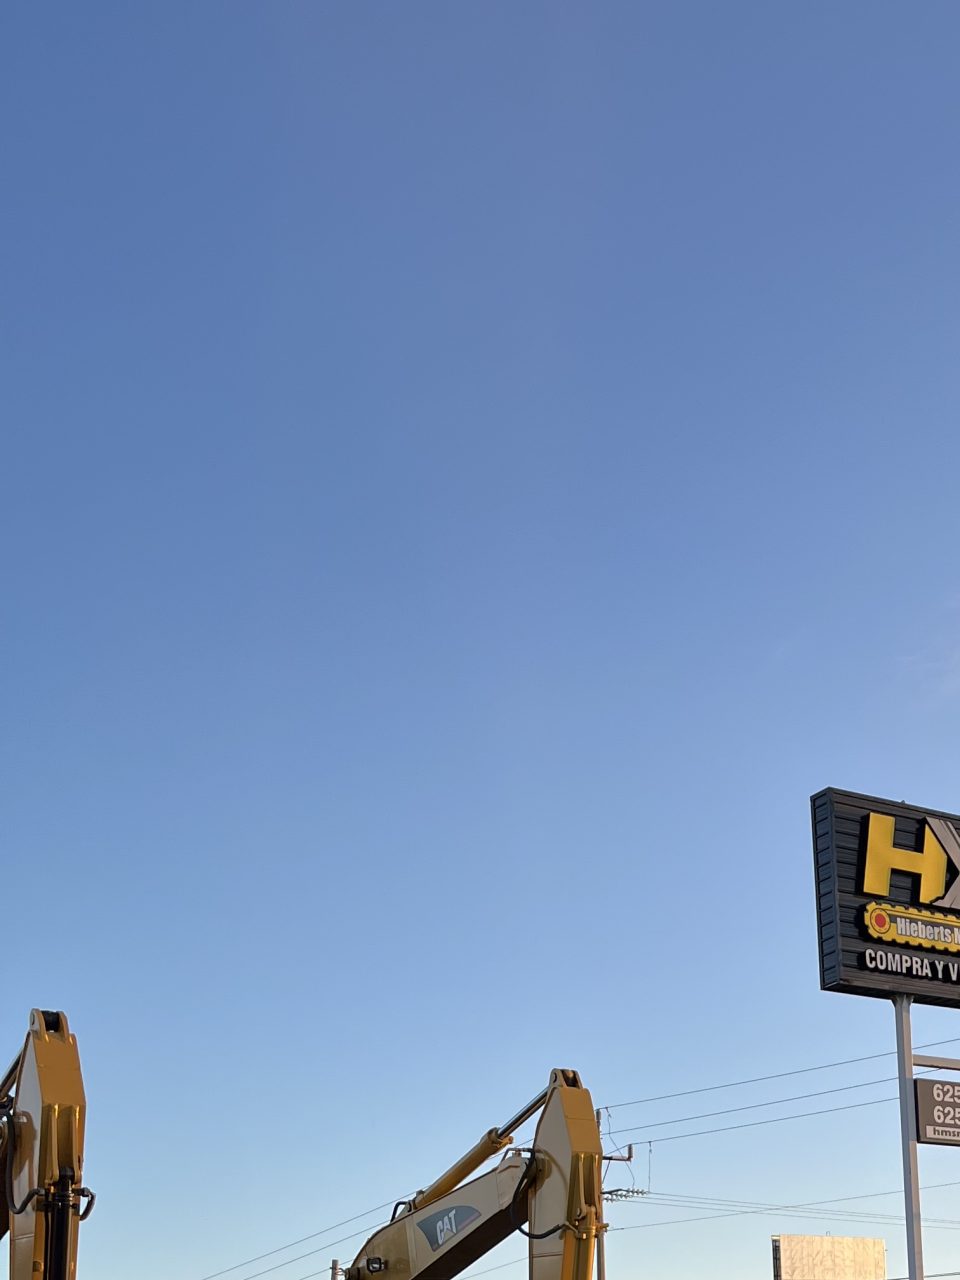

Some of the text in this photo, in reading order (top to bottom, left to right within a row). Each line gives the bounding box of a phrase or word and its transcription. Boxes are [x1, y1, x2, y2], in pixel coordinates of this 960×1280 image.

[896, 917, 952, 943] Hieberts
[865, 948, 932, 977] COMPRA
[935, 959, 945, 979] Y
[436, 1209, 456, 1245] CAT
